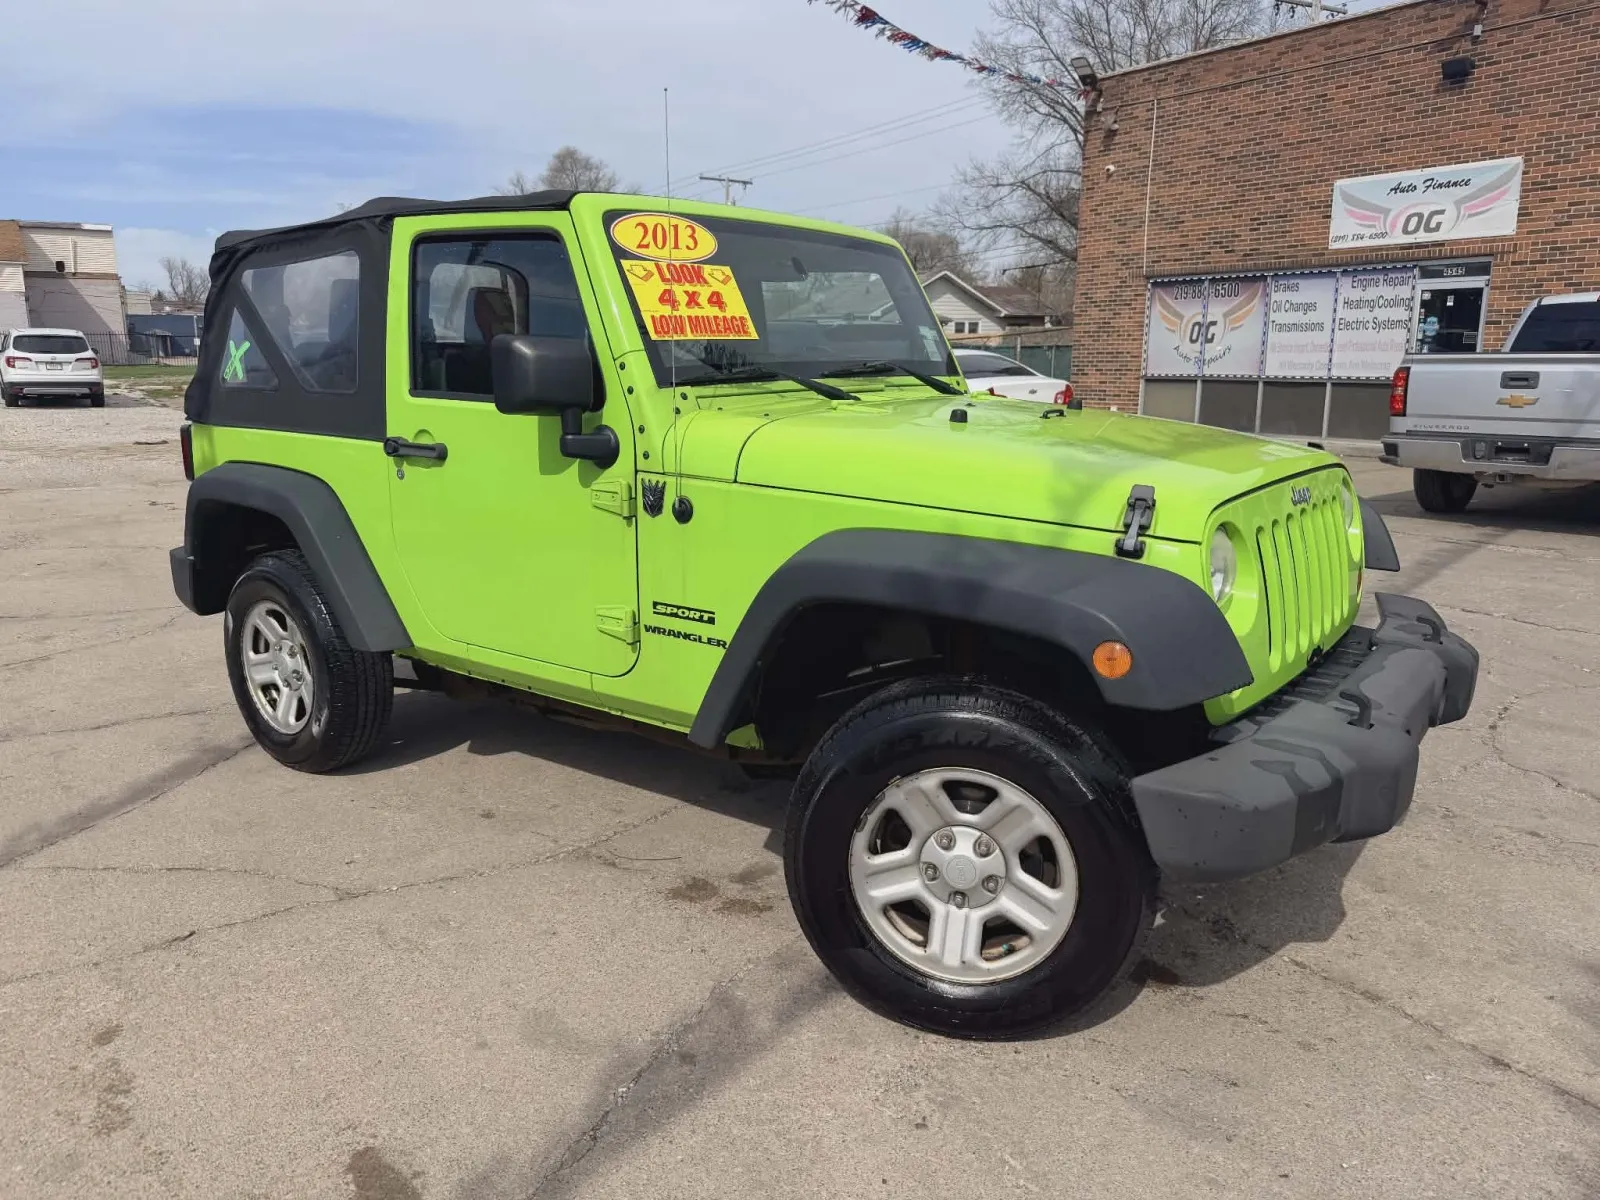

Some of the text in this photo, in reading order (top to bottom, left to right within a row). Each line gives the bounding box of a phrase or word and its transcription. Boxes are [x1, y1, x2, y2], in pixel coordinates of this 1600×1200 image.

[1387, 177, 1472, 196] Auto Finance
[1401, 209, 1447, 235] OG
[634, 222, 699, 251] 2013
[654, 262, 712, 286] LOOK
[1351, 273, 1412, 292] Engine Repair
[1273, 280, 1300, 293] Brakes
[1272, 299, 1317, 315] Oil Changes
[1343, 294, 1411, 312] Heating/Cooling
[651, 314, 751, 338] LOW MILEAGE
[1189, 320, 1218, 344] OG
[1271, 320, 1325, 333] Transmissions
[1338, 317, 1370, 331] Electric
[1372, 316, 1409, 333] Systems
[1173, 344, 1192, 363] Auto
[1290, 485, 1311, 506] Jeep
[654, 604, 716, 621] SPORT
[643, 623, 728, 650] WRANGLER
